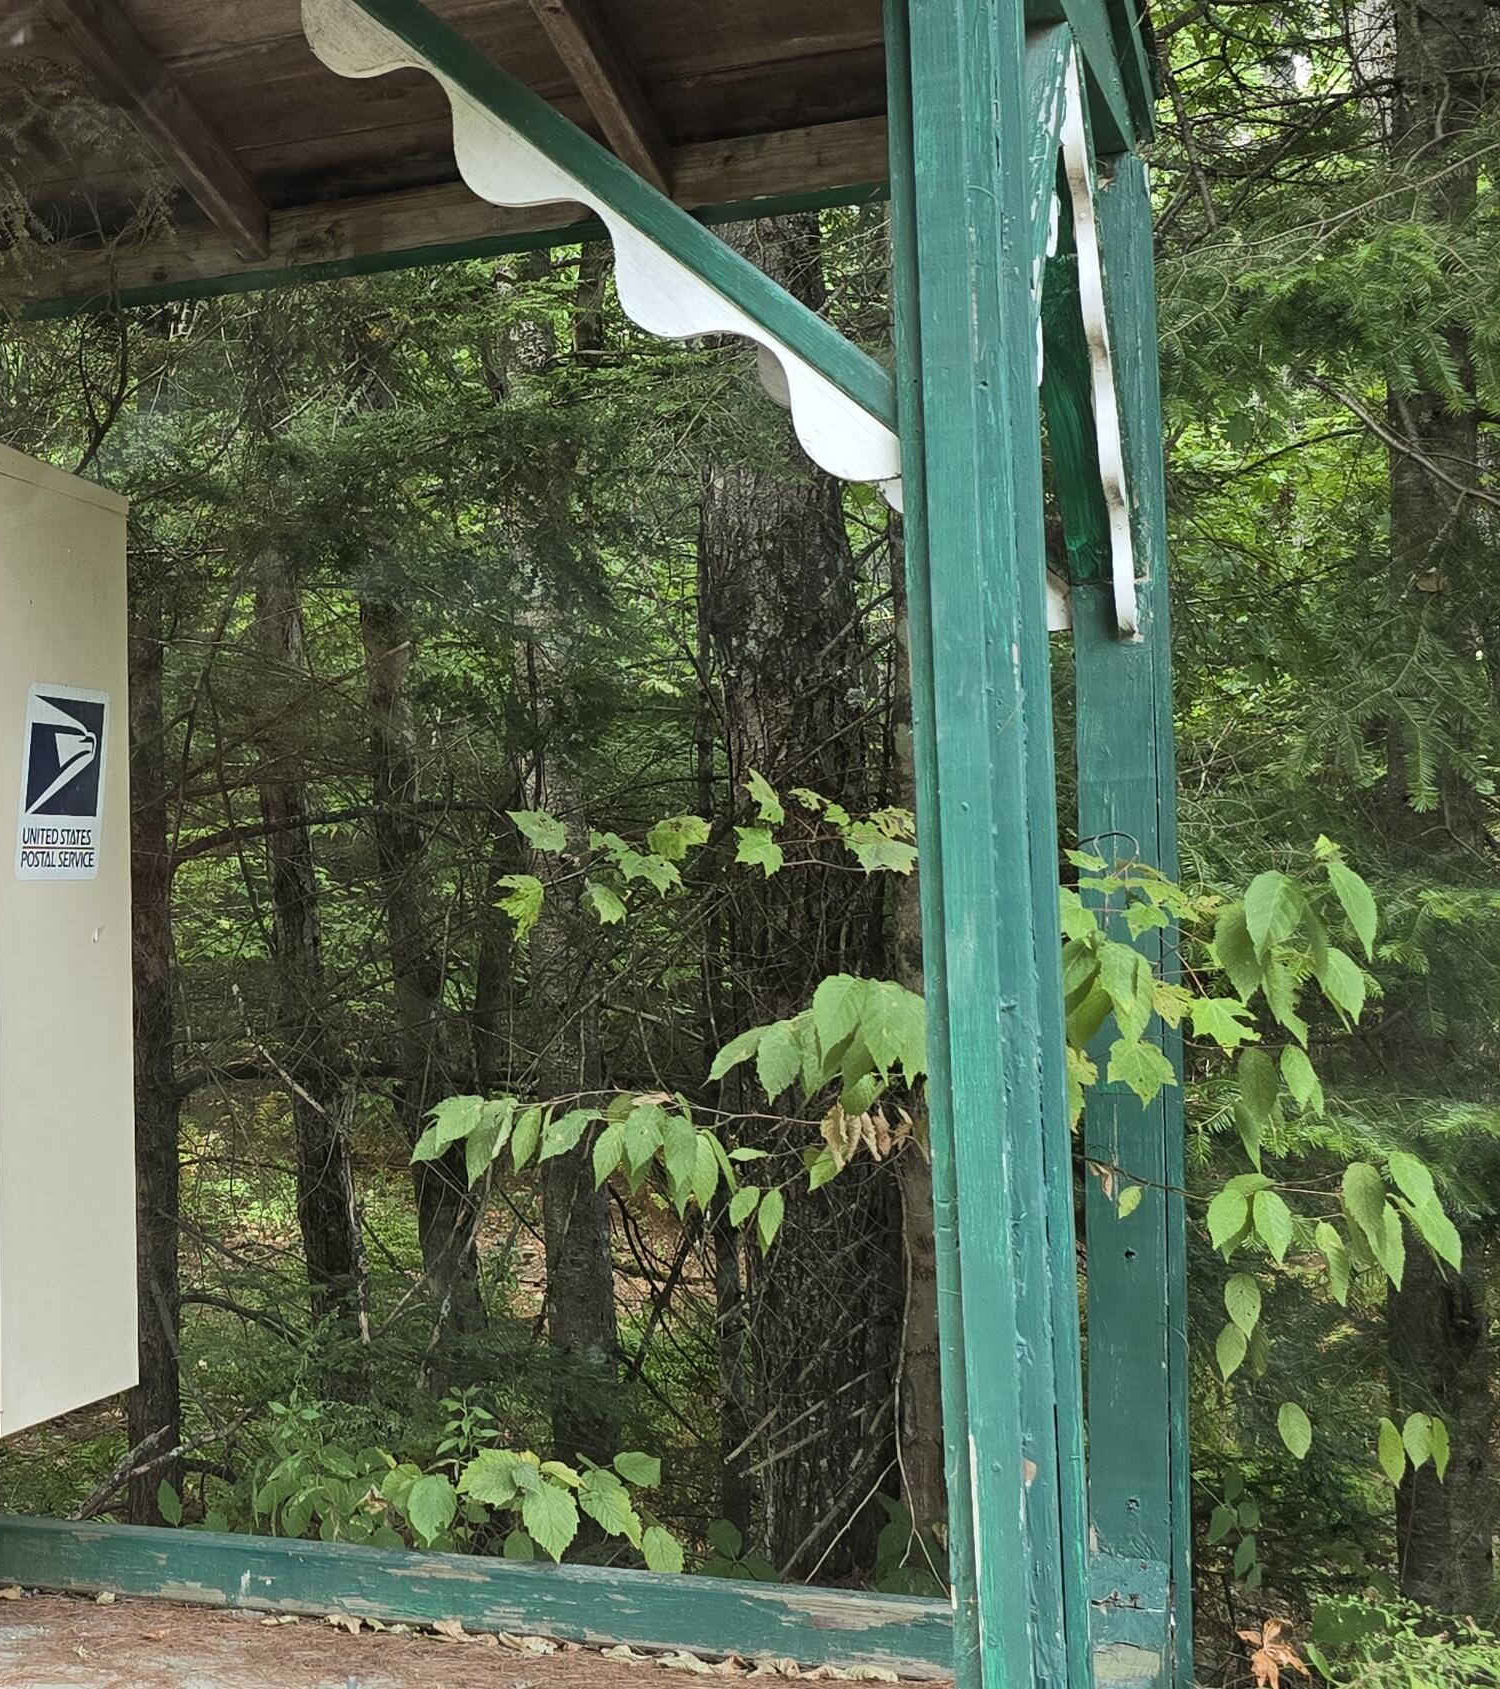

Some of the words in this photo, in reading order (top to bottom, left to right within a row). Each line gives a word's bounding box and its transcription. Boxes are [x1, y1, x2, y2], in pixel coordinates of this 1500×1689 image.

[22, 827, 59, 845] UNITED
[59, 828, 92, 846] STATES
[20, 850, 56, 868] POSTAL
[58, 851, 95, 868] SERVICE
